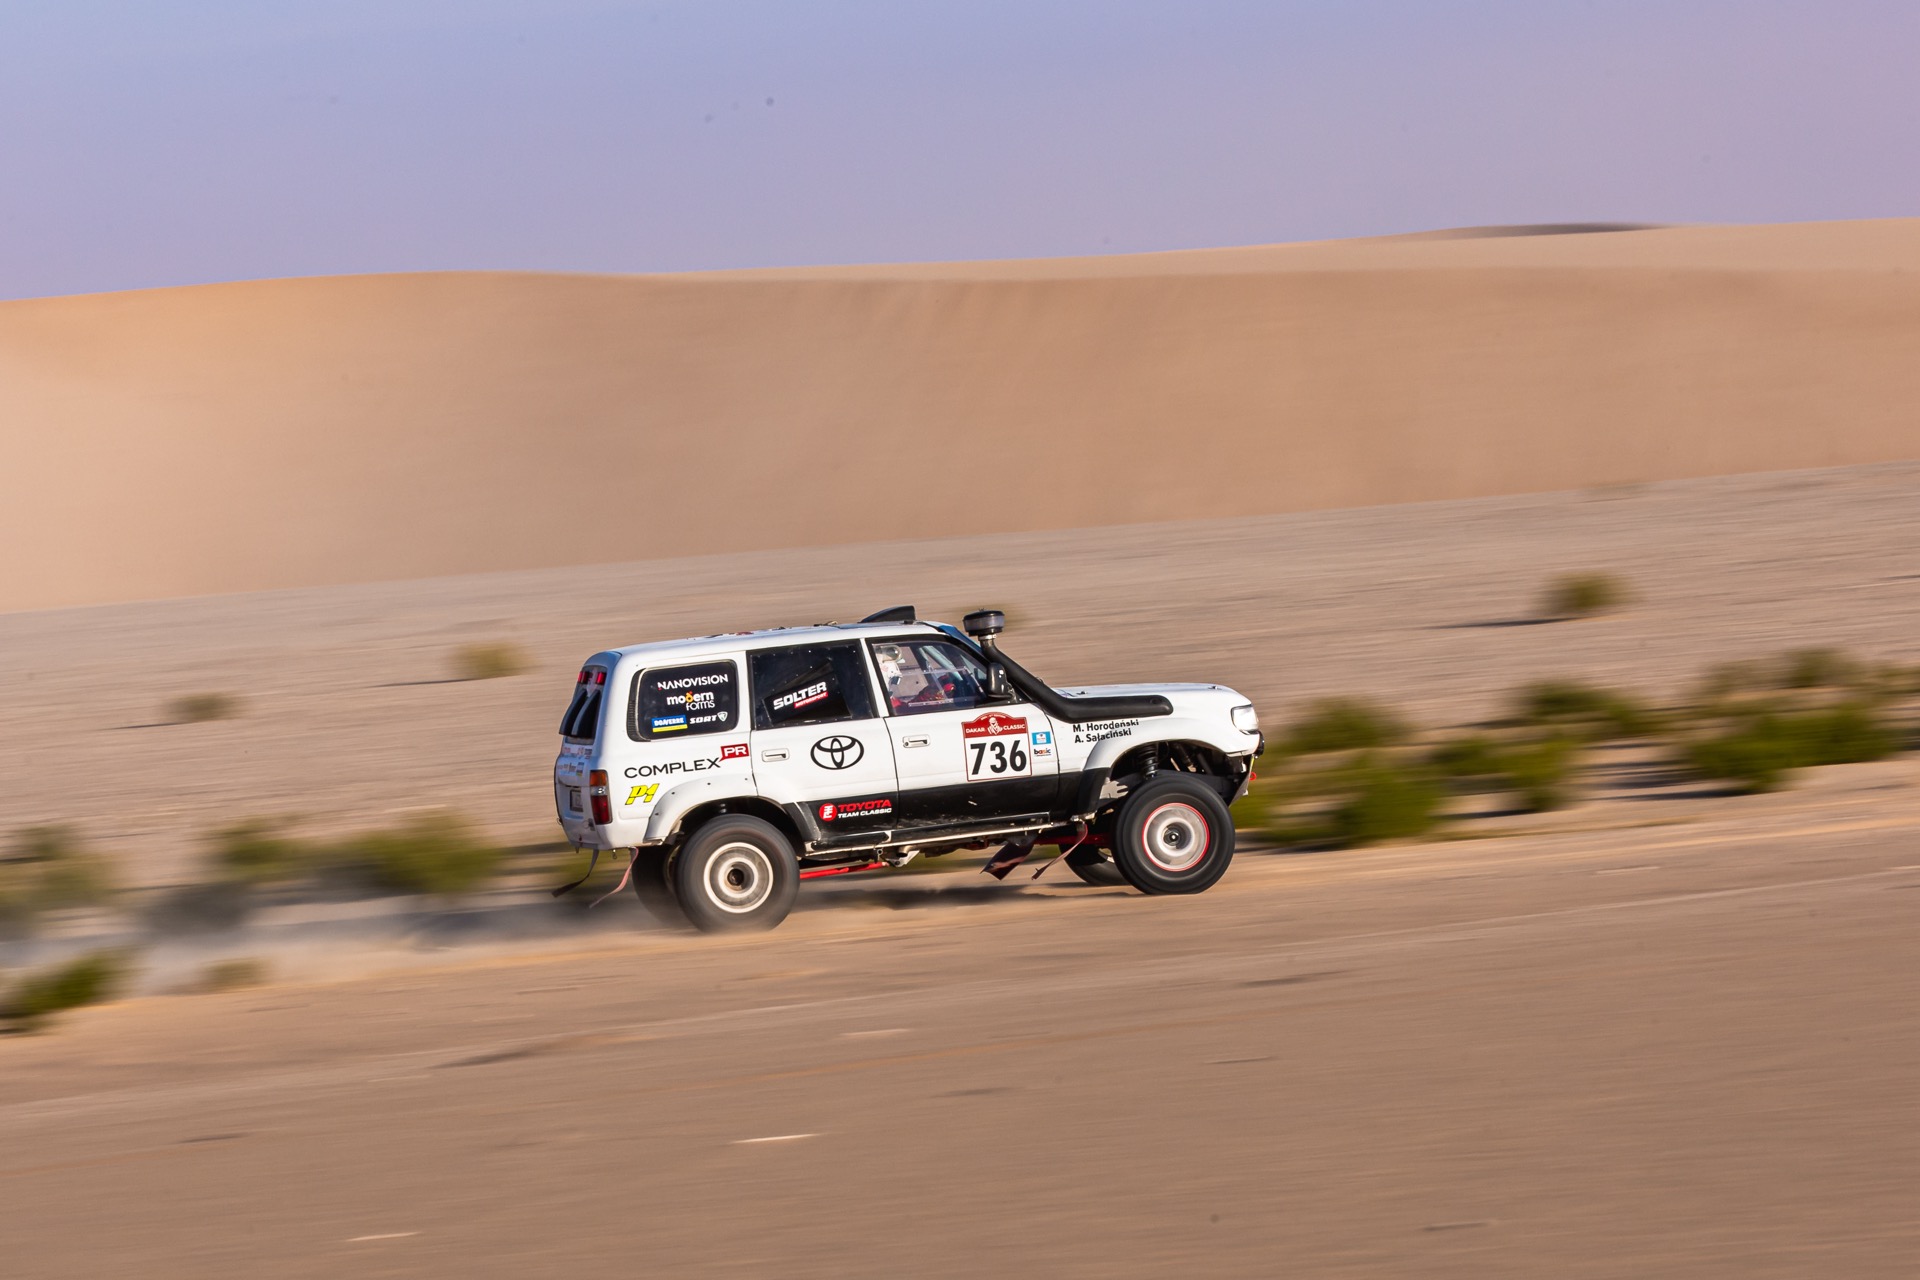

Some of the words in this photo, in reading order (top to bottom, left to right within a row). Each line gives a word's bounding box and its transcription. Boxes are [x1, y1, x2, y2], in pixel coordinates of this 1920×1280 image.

[657, 673, 729, 690] NANOVISION
[773, 681, 827, 710] SOLTER
[1072, 723, 1084, 732] M.
[1074, 735, 1084, 743] A.
[723, 745, 748, 757] PR
[970, 740, 1027, 776] 736
[624, 757, 721, 779] COMPLEX
[838, 799, 892, 812] TOYOTA
[860, 807, 892, 816] CLASSIC
